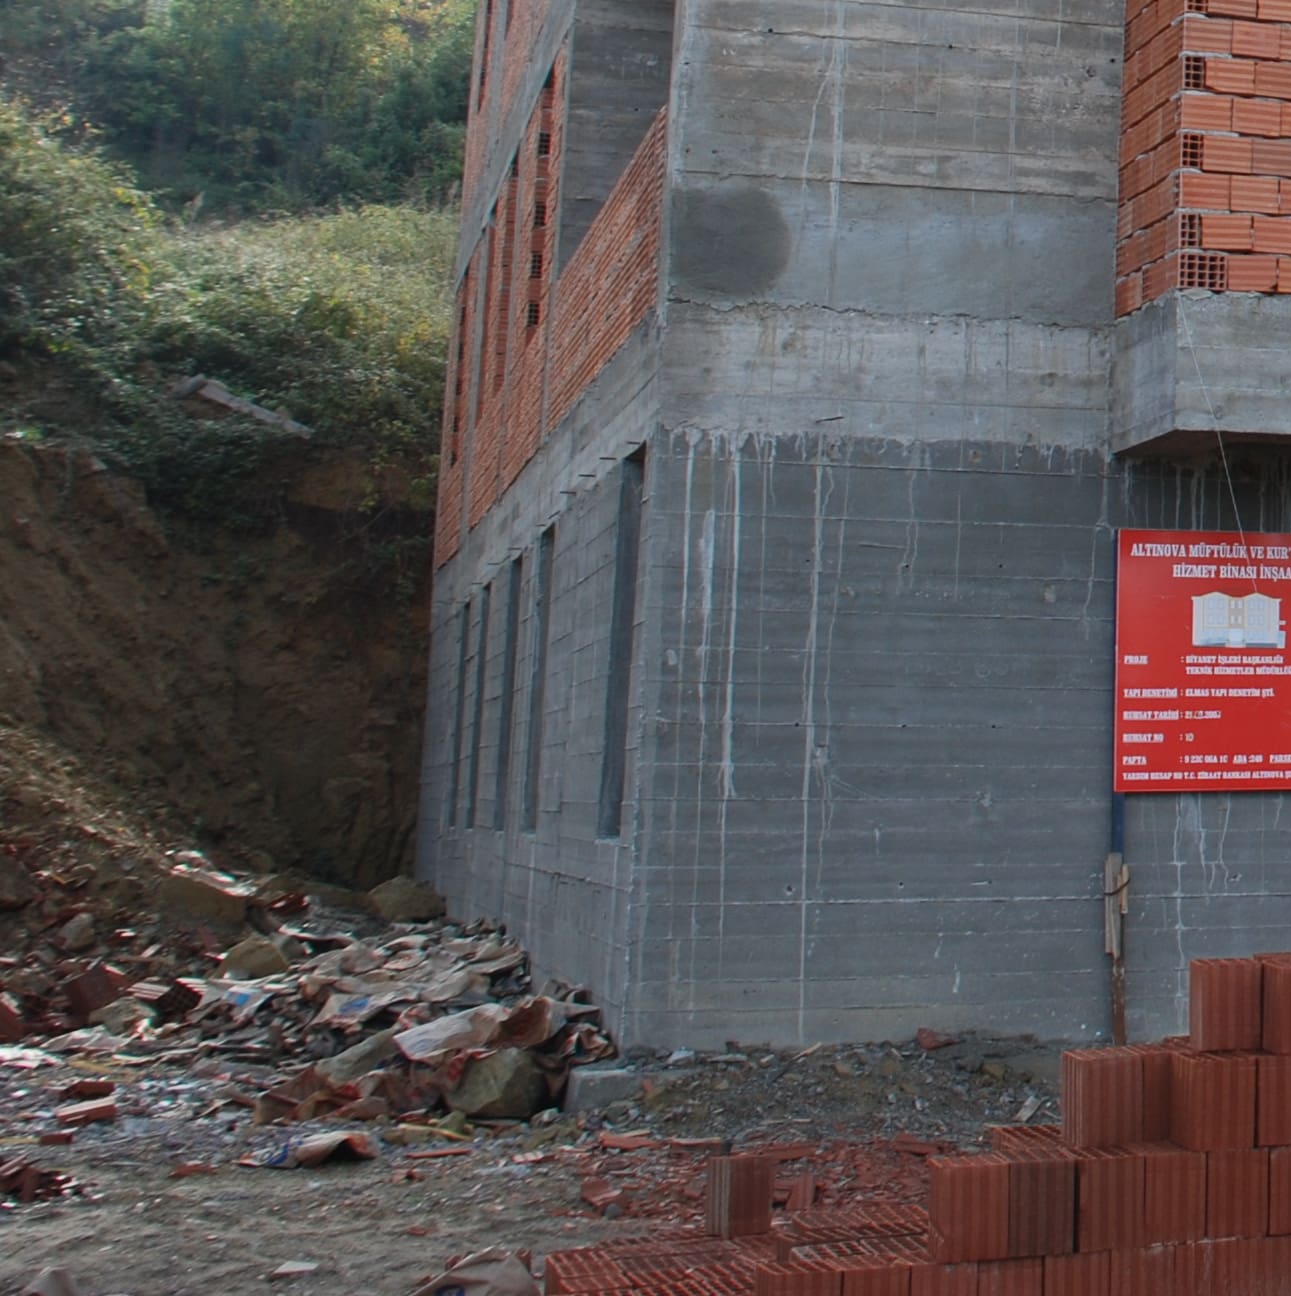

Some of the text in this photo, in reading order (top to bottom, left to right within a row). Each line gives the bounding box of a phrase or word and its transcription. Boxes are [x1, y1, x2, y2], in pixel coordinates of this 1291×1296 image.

[1131, 544, 1185, 557] ALTINOVA
[1251, 548, 1264, 559] VE
[1173, 562, 1217, 577] HİZMET
[1220, 564, 1257, 579] BİNASI
